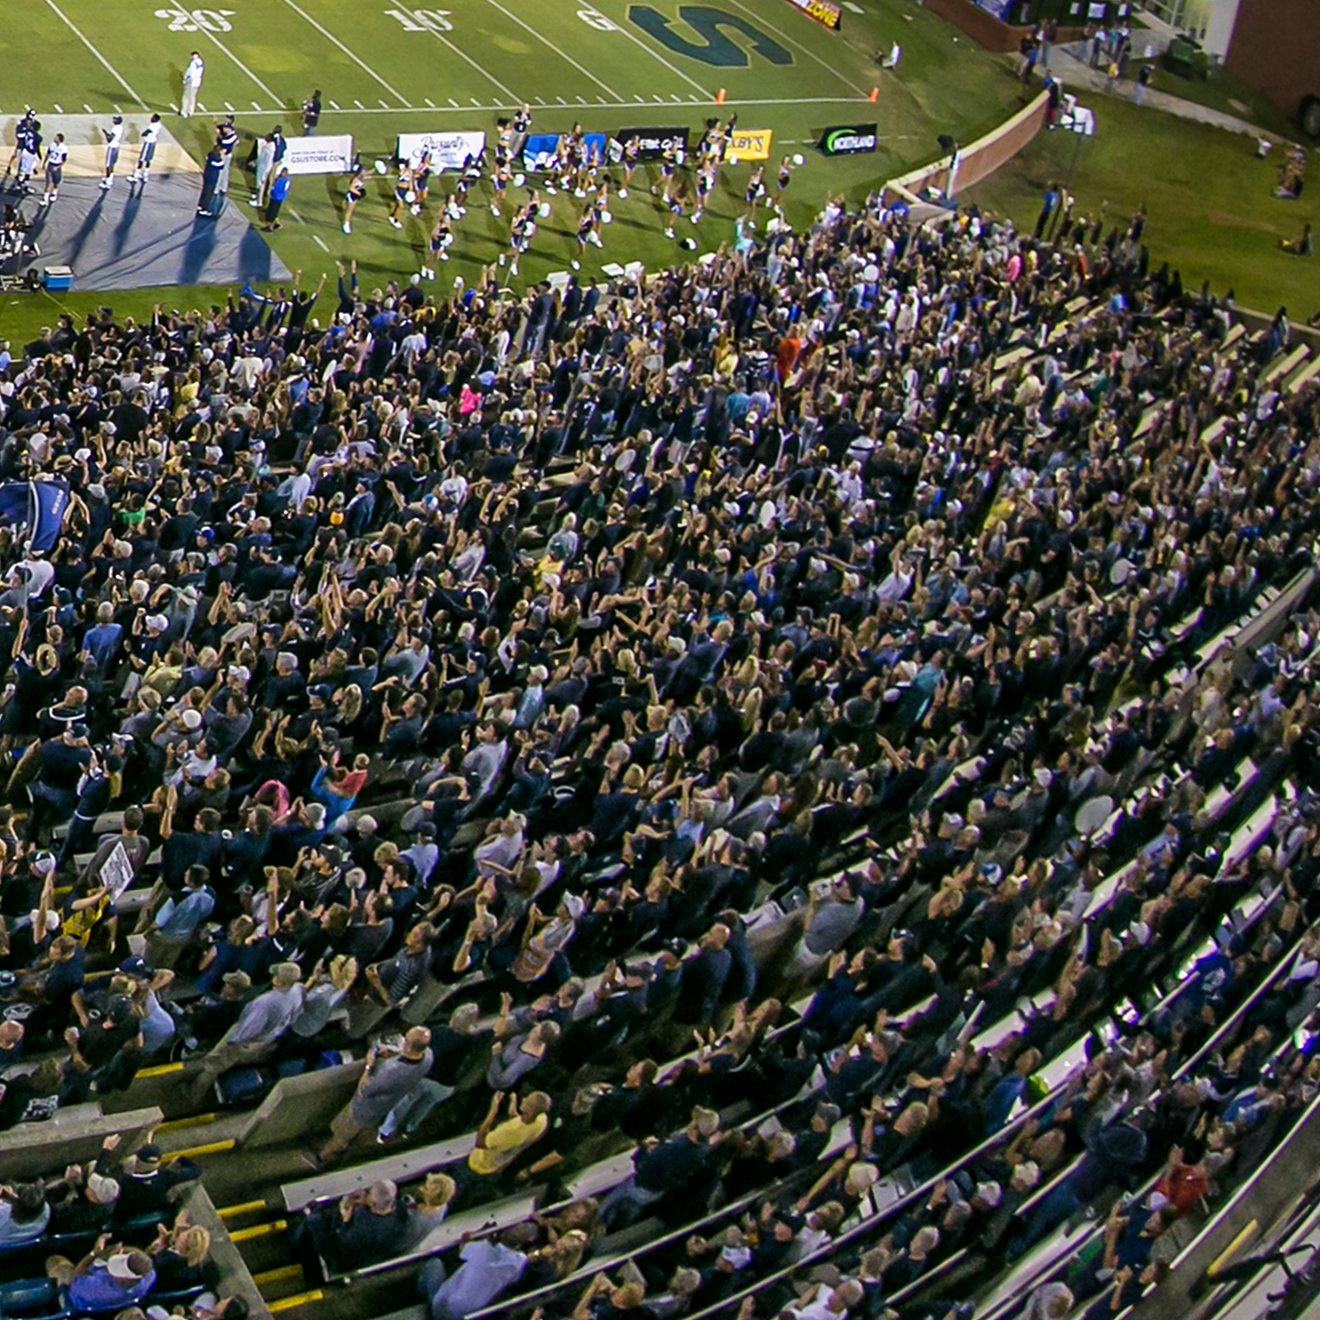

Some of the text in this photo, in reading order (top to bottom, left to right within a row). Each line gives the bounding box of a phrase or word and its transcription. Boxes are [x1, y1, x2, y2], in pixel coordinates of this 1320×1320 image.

[154, 8, 233, 33] 20
[384, 8, 449, 33] 10
[576, 8, 617, 32] 5
